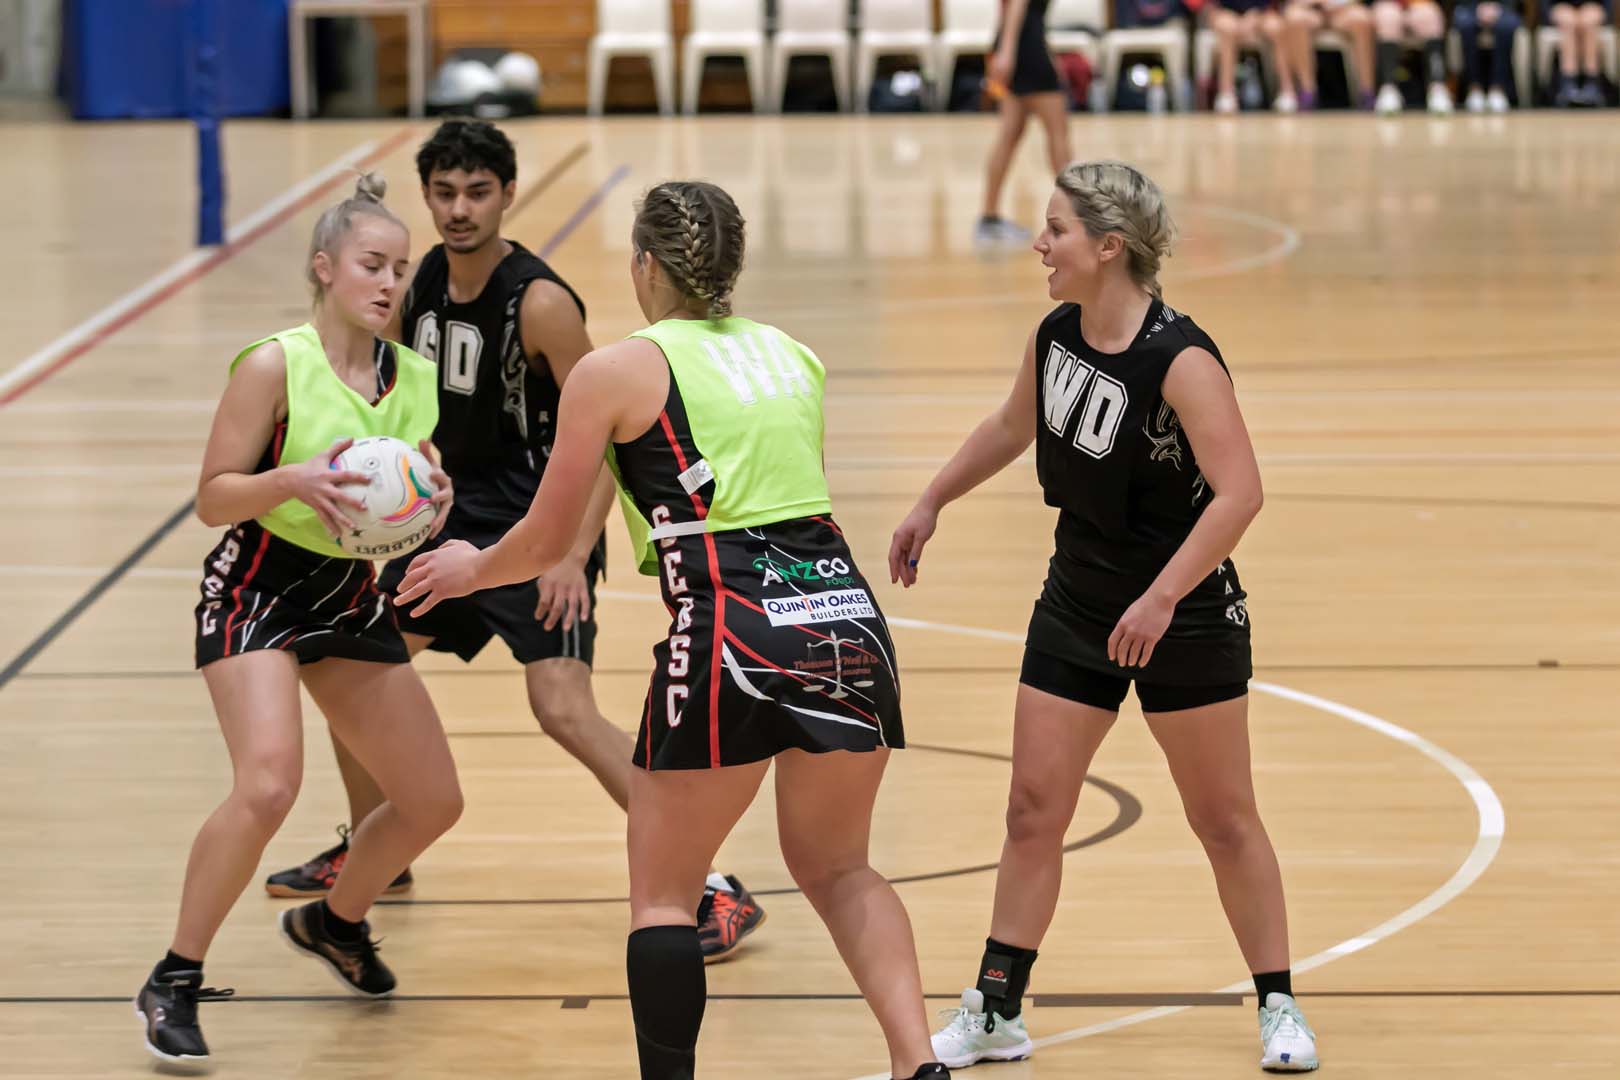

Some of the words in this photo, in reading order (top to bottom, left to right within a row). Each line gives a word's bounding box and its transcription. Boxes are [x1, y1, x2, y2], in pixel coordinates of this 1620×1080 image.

[700, 328, 812, 408] WA
[1043, 340, 1129, 460] WD
[762, 557, 850, 587] ANZCO
[767, 597, 826, 615] QUINTIN
[828, 593, 869, 607] OAKES
[810, 607, 858, 620] BUILDERS
[860, 606, 874, 615] LTD
